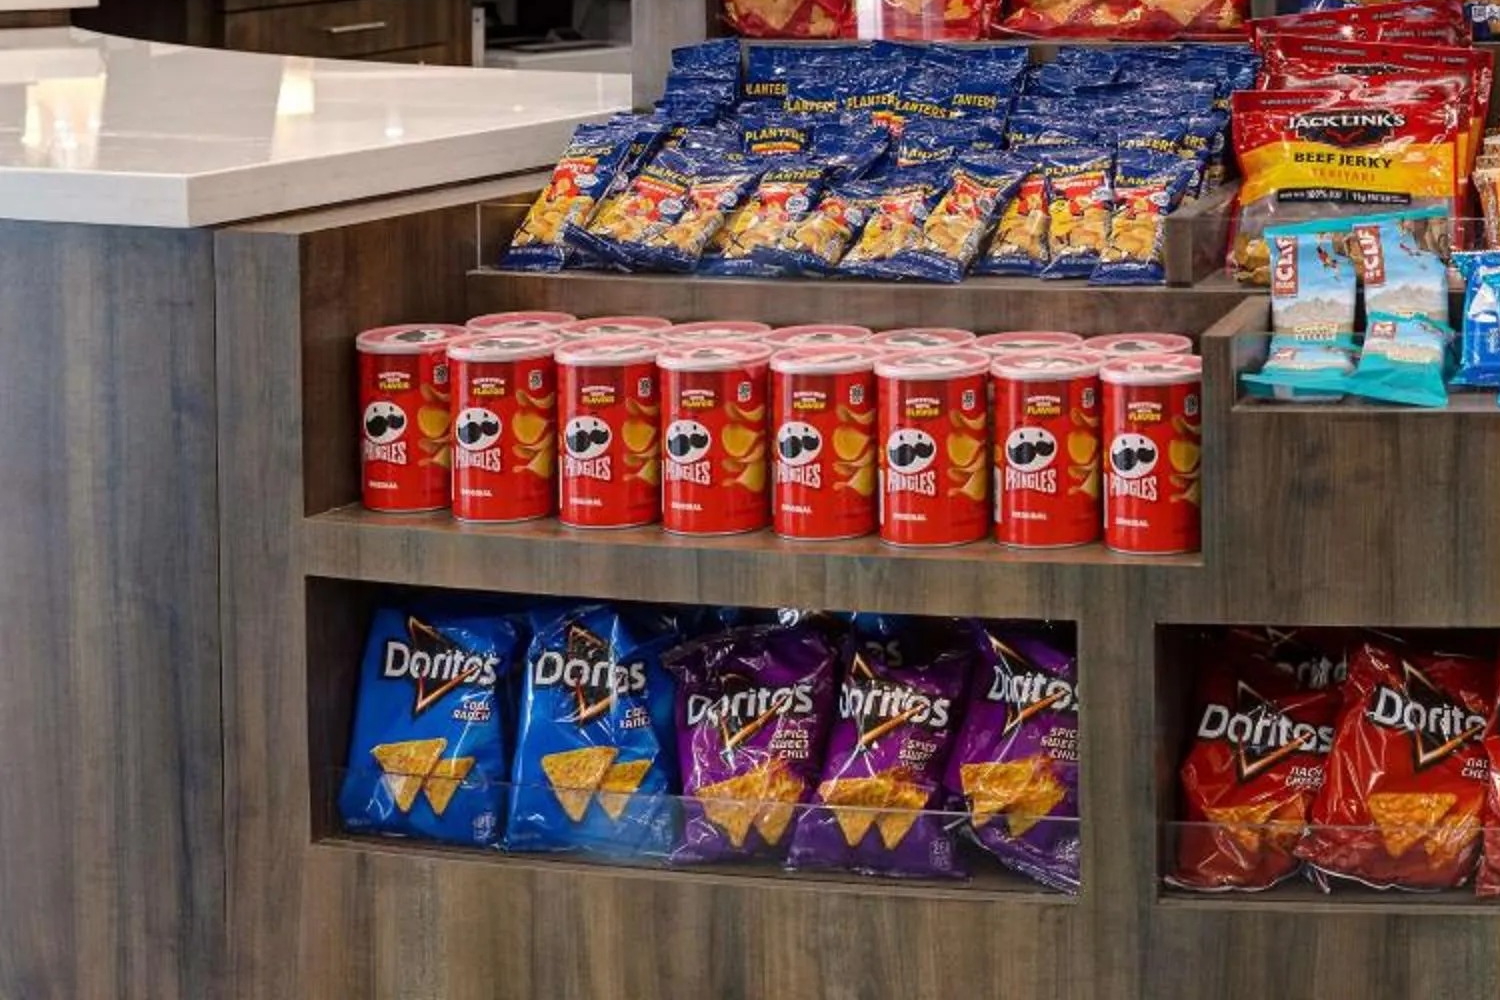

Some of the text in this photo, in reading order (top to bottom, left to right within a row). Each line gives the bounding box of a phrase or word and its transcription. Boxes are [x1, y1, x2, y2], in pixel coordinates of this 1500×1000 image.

[1289, 116, 1339, 129] JACK
[1294, 152, 1393, 169] BEEF JERKY
[887, 469, 936, 496] PRINGLES
[1005, 467, 1057, 494] PRINGLES
[1110, 473, 1157, 502] PRINGLES
[384, 641, 501, 686] Doritos
[1374, 686, 1488, 741] Dorito
[1049, 727, 1077, 738] SPIC
[1197, 703, 1335, 752] Doritos
[1050, 748, 1079, 761] CHIL
[1461, 767, 1488, 779] CHE
